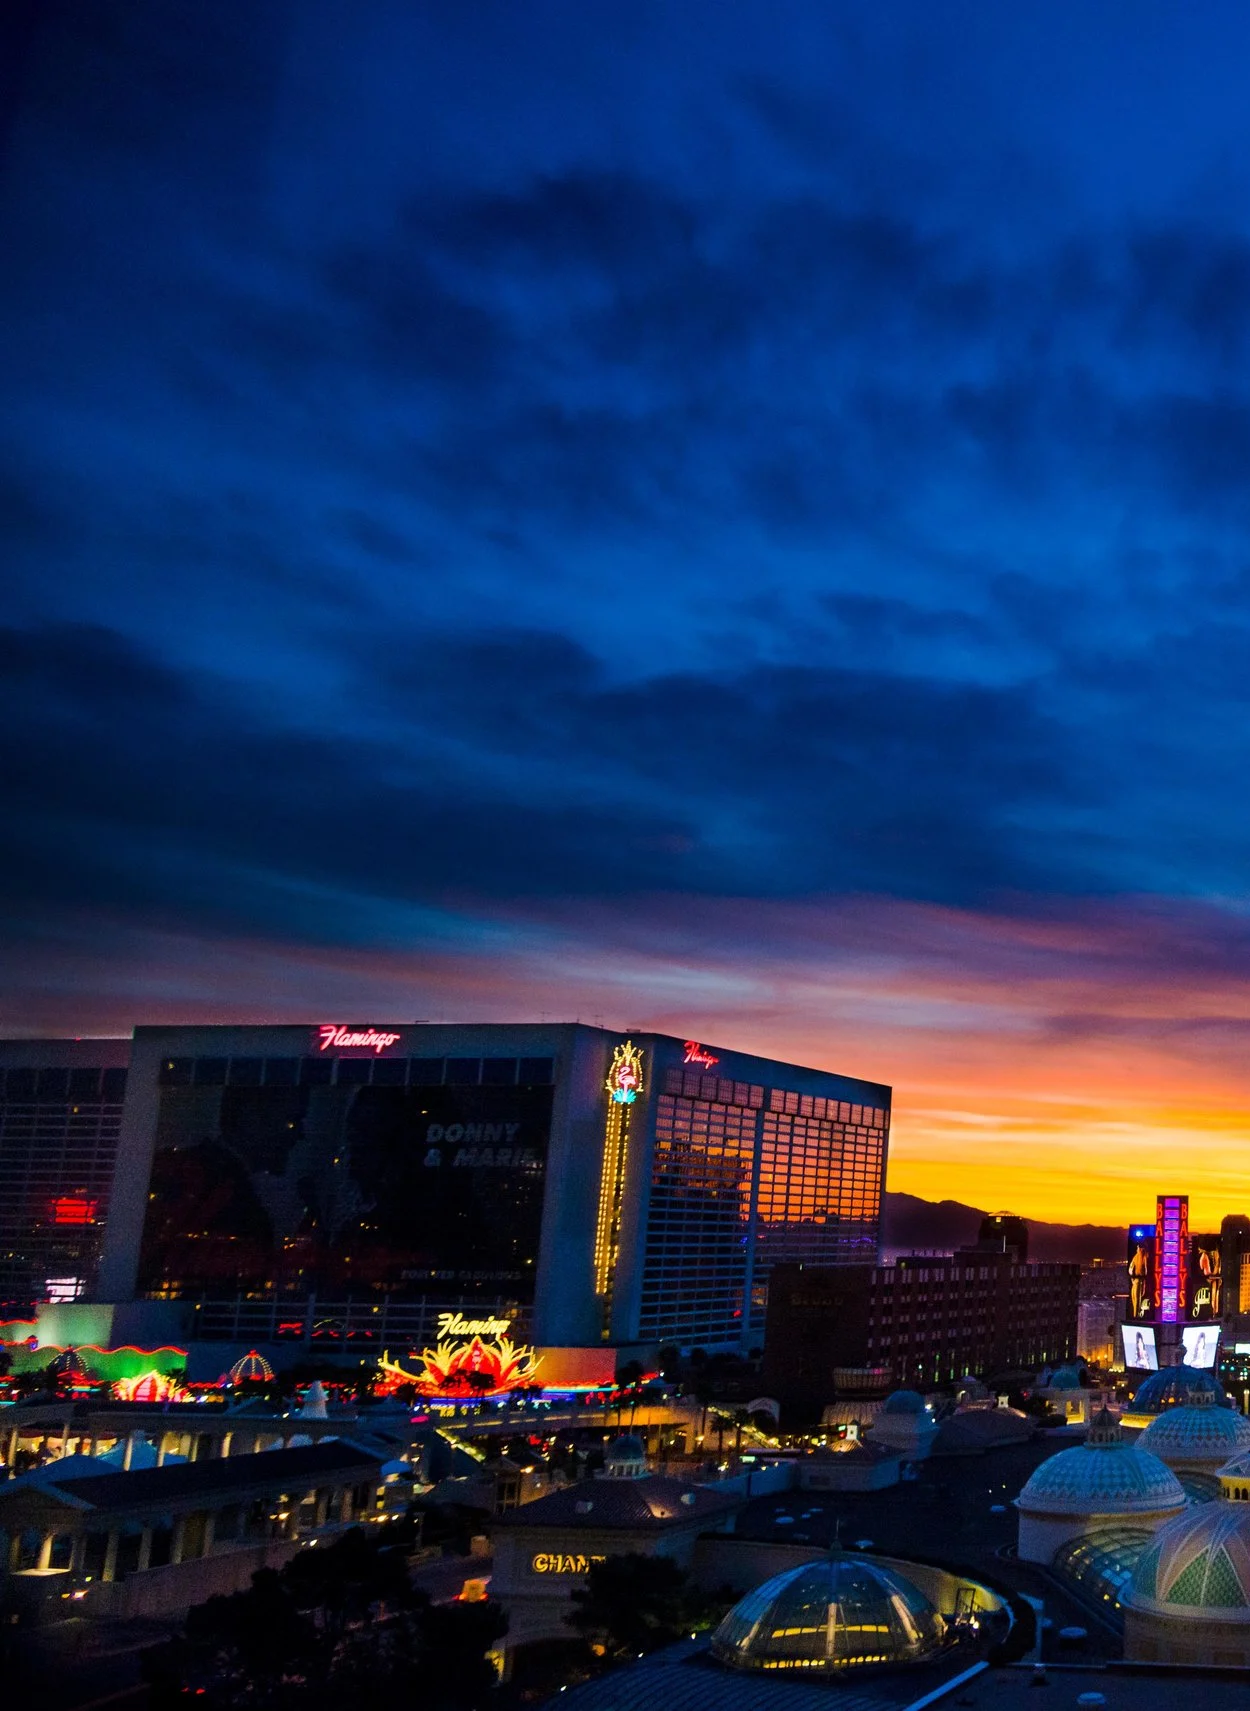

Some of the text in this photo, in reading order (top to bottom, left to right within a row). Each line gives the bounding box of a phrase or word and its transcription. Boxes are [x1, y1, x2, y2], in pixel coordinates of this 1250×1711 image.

[319, 1023, 401, 1053] Flamingo
[425, 1121, 521, 1143] DONNY
[423, 1148, 442, 1167] &
